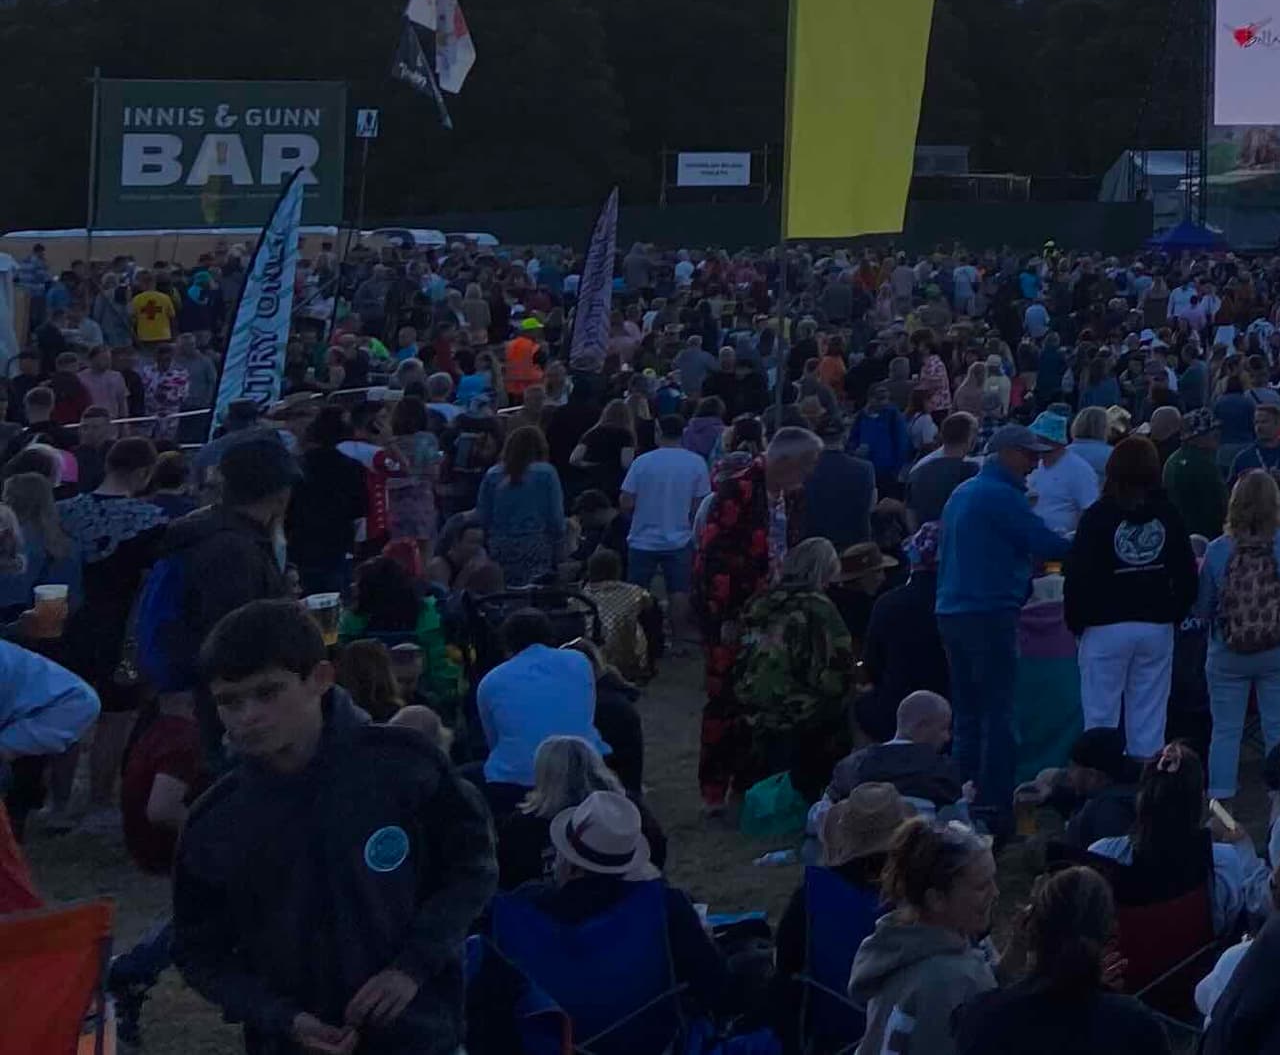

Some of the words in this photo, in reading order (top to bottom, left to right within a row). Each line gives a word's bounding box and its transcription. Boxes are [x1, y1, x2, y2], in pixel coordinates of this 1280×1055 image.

[122, 106, 205, 126] INNIS
[214, 103, 238, 128] &
[245, 107, 321, 126] GUNN
[121, 133, 320, 186] BAR
[256, 230, 287, 319] ONLY
[239, 329, 279, 415] NTRY
